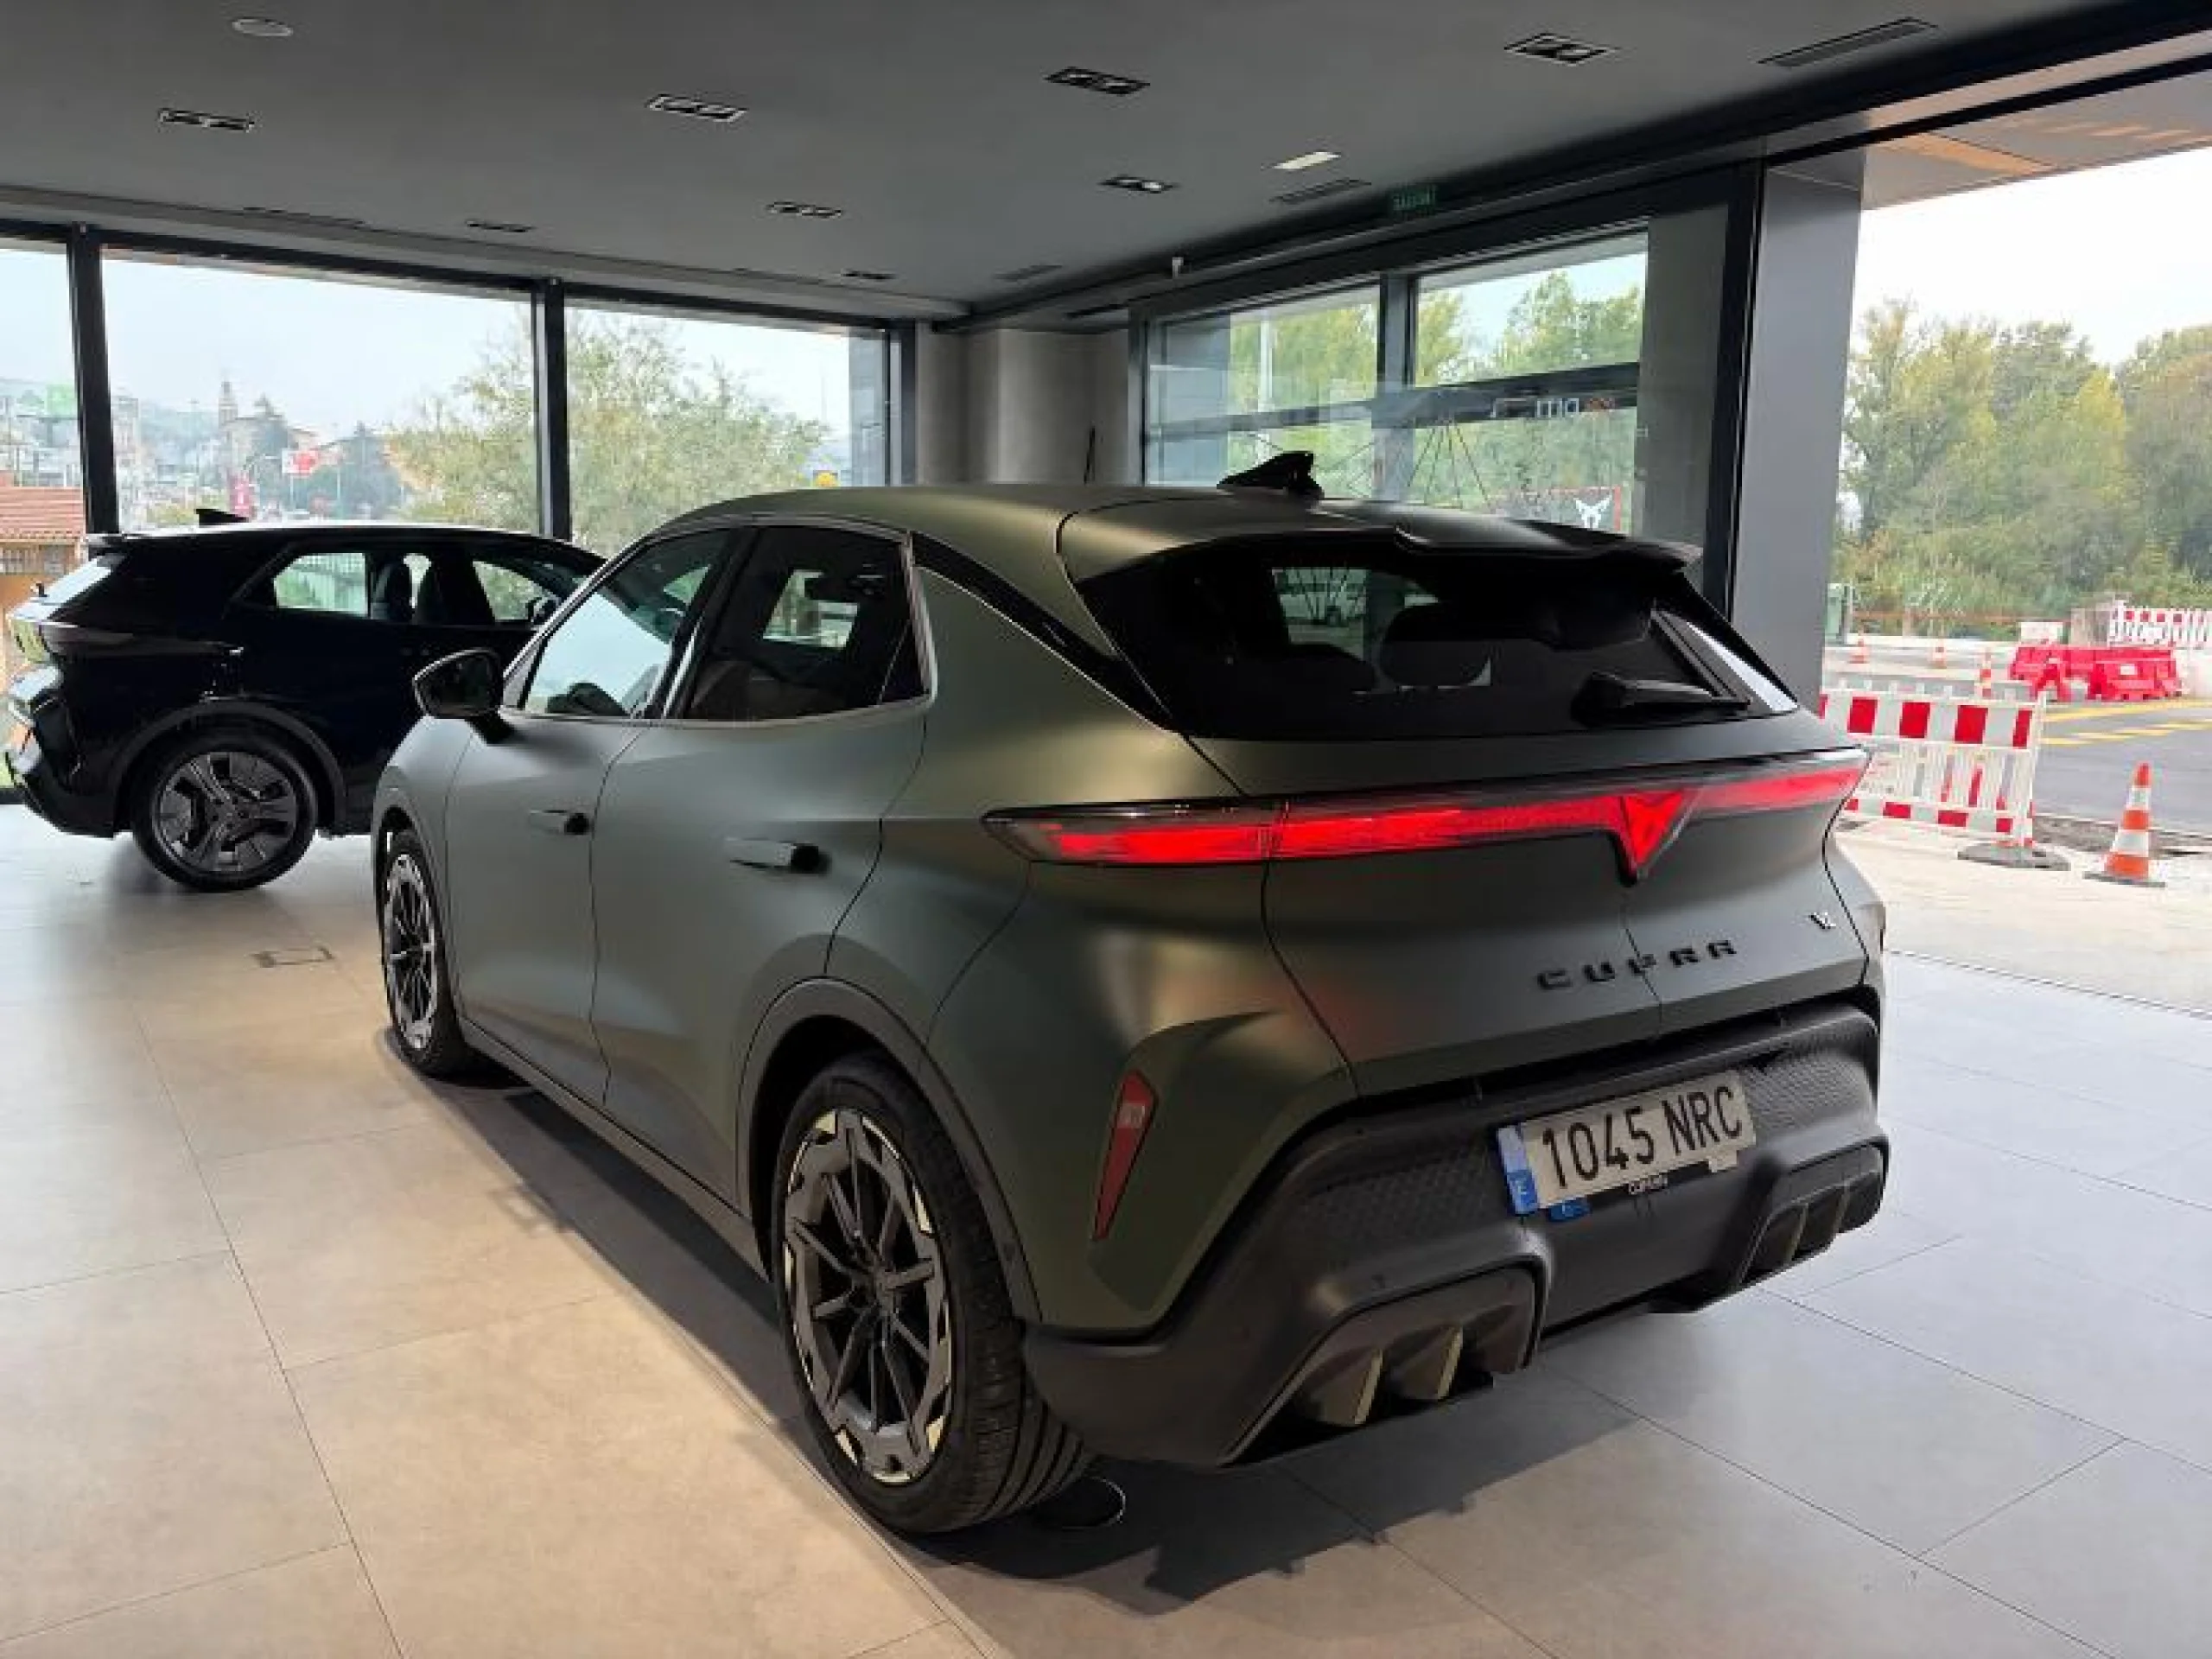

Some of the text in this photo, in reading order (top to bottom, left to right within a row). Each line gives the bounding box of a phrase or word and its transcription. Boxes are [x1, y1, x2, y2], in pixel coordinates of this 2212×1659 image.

[1536, 938, 1738, 990] CUPRA
[1542, 1086, 1742, 1189] 1045 NRC
